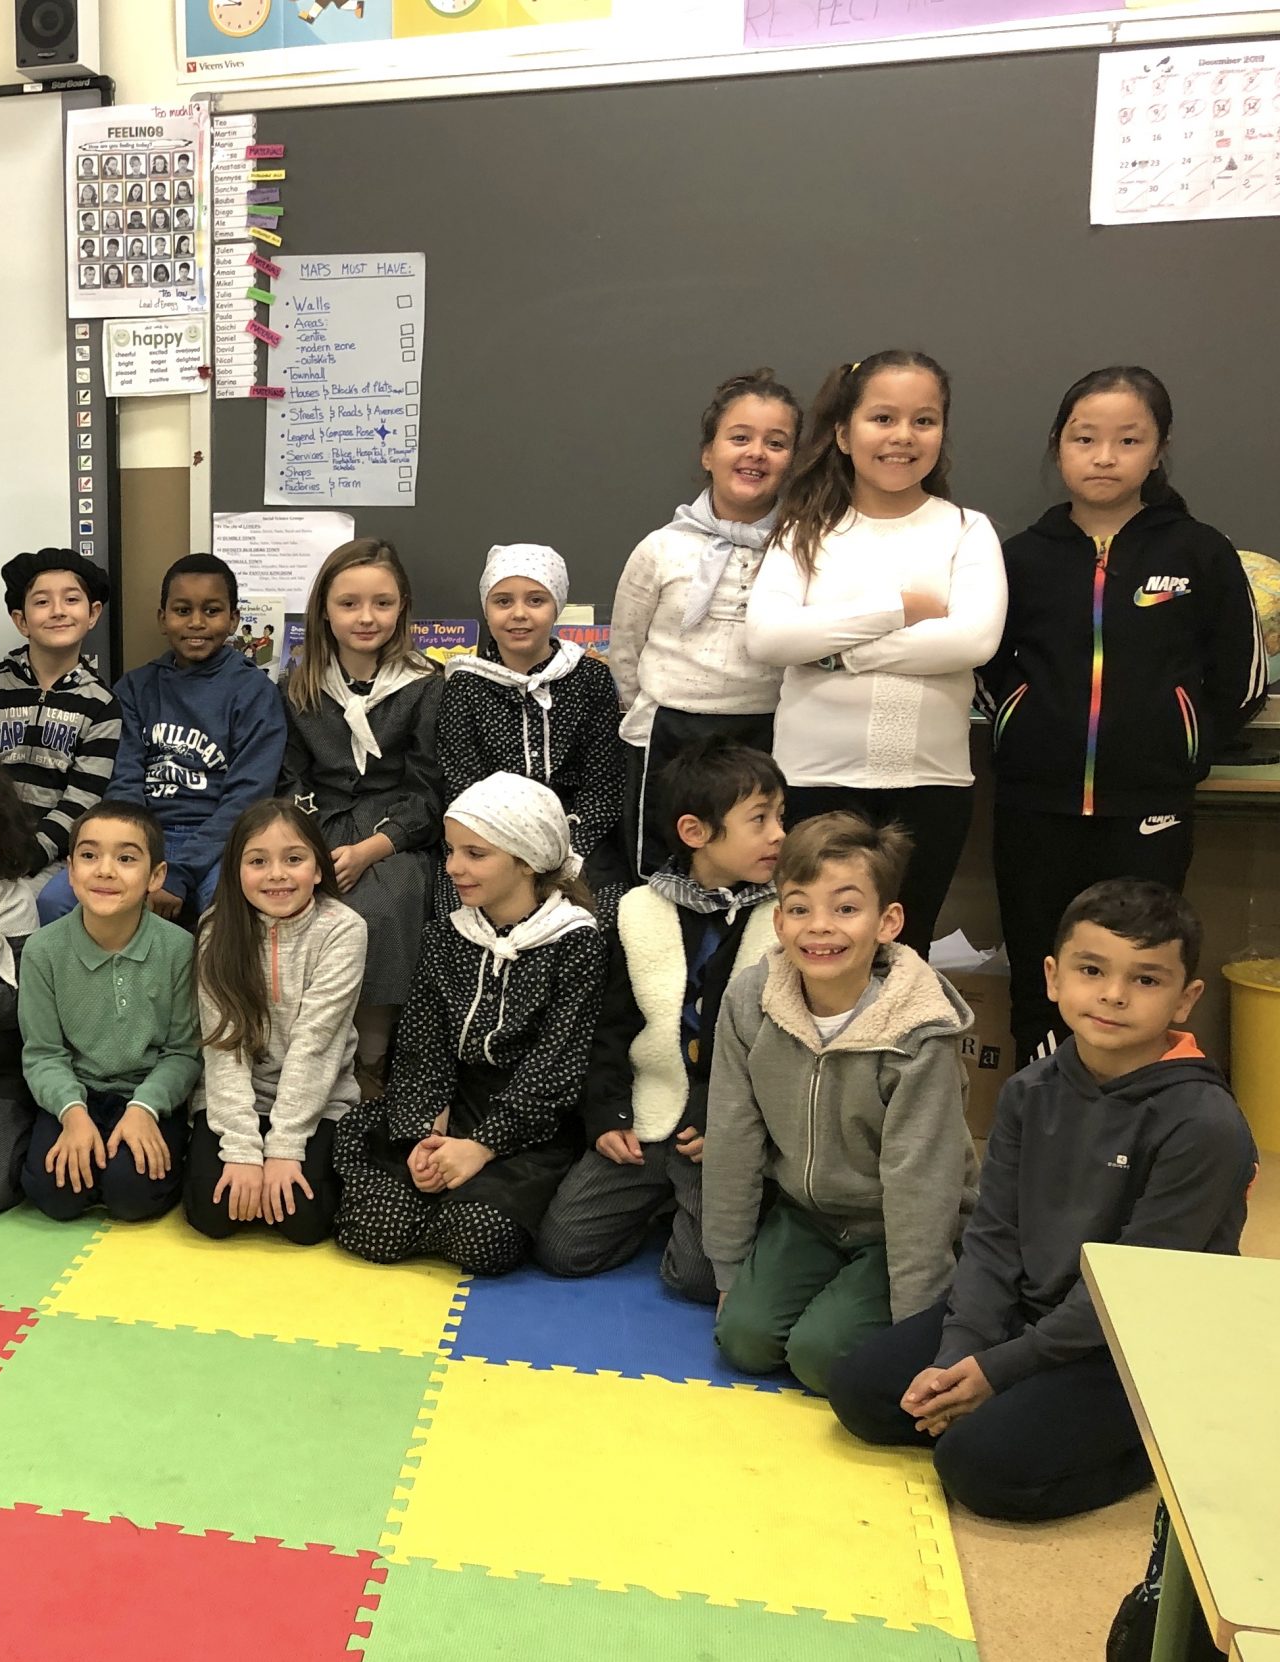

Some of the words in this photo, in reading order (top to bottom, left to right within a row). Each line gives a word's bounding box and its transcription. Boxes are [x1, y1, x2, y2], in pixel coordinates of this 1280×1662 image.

[199, 62, 224, 71] Vicens
[224, 60, 245, 68] Vives
[1198, 57, 1241, 66] December
[51, 79, 91, 90] StarBoard
[108, 126, 164, 138] FEELINGS
[1122, 136, 1131, 144] 15
[1152, 134, 1162, 142] 16
[1184, 131, 1193, 139] 17
[1215, 129, 1224, 137] 18
[1246, 128, 1255, 136] 19
[1120, 161, 1129, 169] 22
[1181, 157, 1192, 165] 24
[1118, 186, 1128, 194] 29
[1149, 185, 1159, 193] 30
[300, 263, 332, 277] MAPS
[341, 262, 368, 275] MUST
[377, 262, 412, 275] HAVE:
[293, 295, 331, 312] Walls
[132, 330, 184, 349] happy
[334, 342, 356, 351] zone
[286, 367, 325, 380] Townhall
[290, 386, 320, 399] Houses
[332, 384, 359, 395] Blocks
[362, 382, 370, 394] of
[290, 405, 324, 422] Streets
[338, 404, 364, 418] Roads
[374, 406, 404, 416] Avenues
[287, 429, 315, 447] Legend
[325, 427, 354, 443] Compass
[356, 425, 375, 437] Rose
[286, 450, 324, 461] Services
[285, 466, 312, 480] Shops
[285, 479, 320, 491] Factories
[338, 477, 361, 488] Farm
[1145, 576, 1190, 592] NAPS
[410, 624, 429, 634] the
[433, 624, 465, 634] Town
[419, 636, 438, 644] First
[152, 722, 229, 772] WILDCAT
[961, 1037, 975, 1055] R
